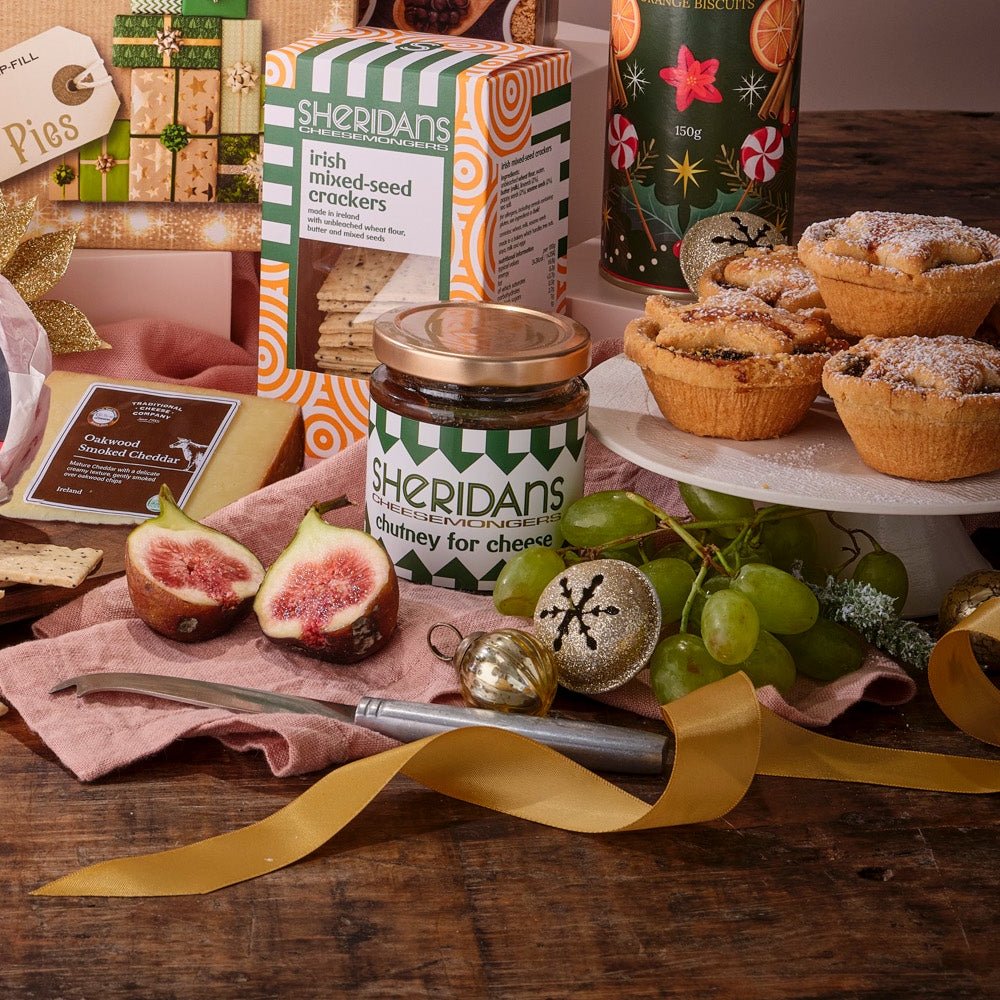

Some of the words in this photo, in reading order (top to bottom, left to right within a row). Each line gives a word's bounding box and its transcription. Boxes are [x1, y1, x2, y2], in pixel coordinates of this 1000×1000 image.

[1, 114, 79, 165] Pies
[298, 126, 449, 151] CHEESEMONGERS
[675, 125, 702, 140] 150g
[310, 149, 346, 170] irish
[309, 170, 412, 197] mixed-seed
[308, 189, 387, 212] crackers
[307, 208, 327, 216] made
[328, 209, 335, 217] in
[336, 210, 360, 221] ireland
[307, 216, 322, 224] with
[324, 218, 363, 230] unbleached
[364, 224, 386, 233] wheat
[387, 226, 406, 236] flour,
[307, 224, 327, 234] butter
[328, 228, 342, 236] and
[343, 230, 365, 239] mixed
[366, 233, 385, 242] seeds
[131, 401, 183, 412] TRADITIONAL
[139, 406, 171, 414] CHEESE
[132, 411, 171, 420] COMPANY
[84, 433, 140, 449] Oakwood
[77, 443, 127, 458] Smoked
[128, 450, 180, 465] Cheddar
[66, 466, 89, 474] creamy
[89, 470, 112, 478] texture,
[112, 472, 131, 480] gently
[69, 460, 91, 468] Mature
[91, 463, 117, 471] Cheddar
[117, 466, 130, 474] with
[136, 469, 160, 477] delicate
[77, 472, 105, 482] oakwood
[56, 486, 83, 495] Ireland
[371, 492, 562, 529] CHEESEMONGERS
[376, 513, 441, 552] chutney
[446, 532, 479, 552] for
[486, 533, 553, 553] cheese
